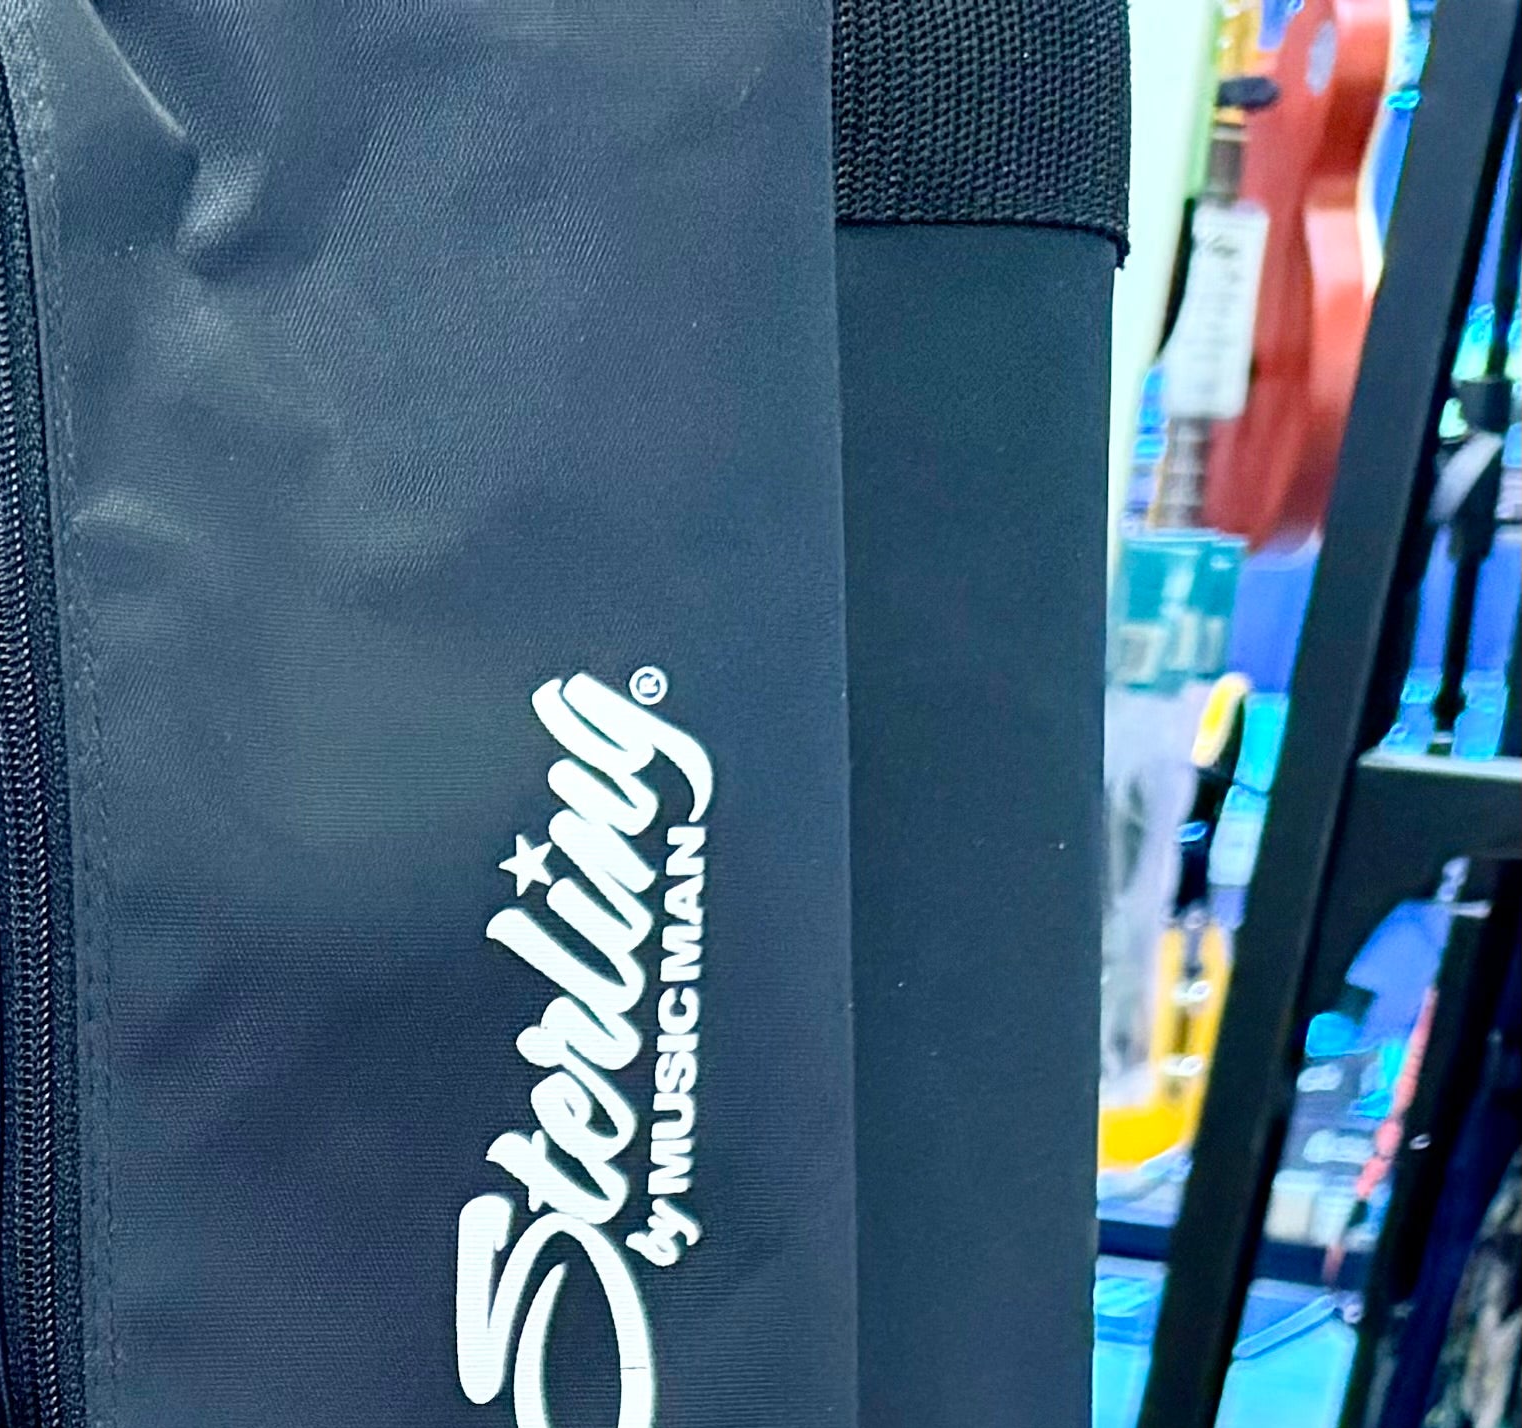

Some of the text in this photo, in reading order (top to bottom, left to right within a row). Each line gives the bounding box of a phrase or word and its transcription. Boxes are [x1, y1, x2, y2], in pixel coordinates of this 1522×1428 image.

[624, 824, 707, 1268] by MUSIC MAN
